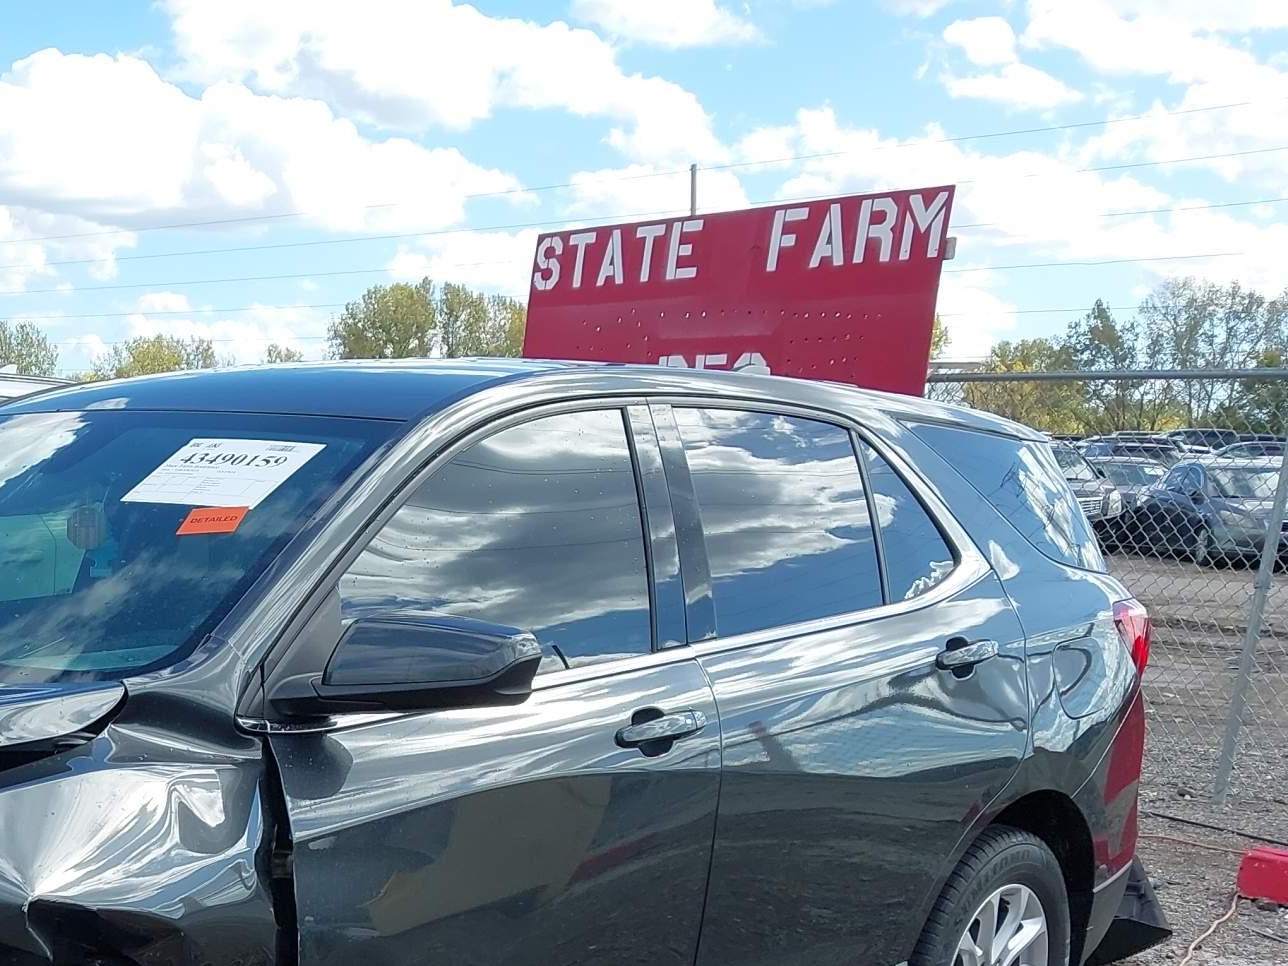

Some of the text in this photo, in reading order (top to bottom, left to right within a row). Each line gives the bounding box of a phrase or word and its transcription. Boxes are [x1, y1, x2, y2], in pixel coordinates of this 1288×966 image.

[533, 191, 949, 291] STATE FARM
[180, 451, 289, 469] 43490159
[190, 515, 239, 524] DETAILED
